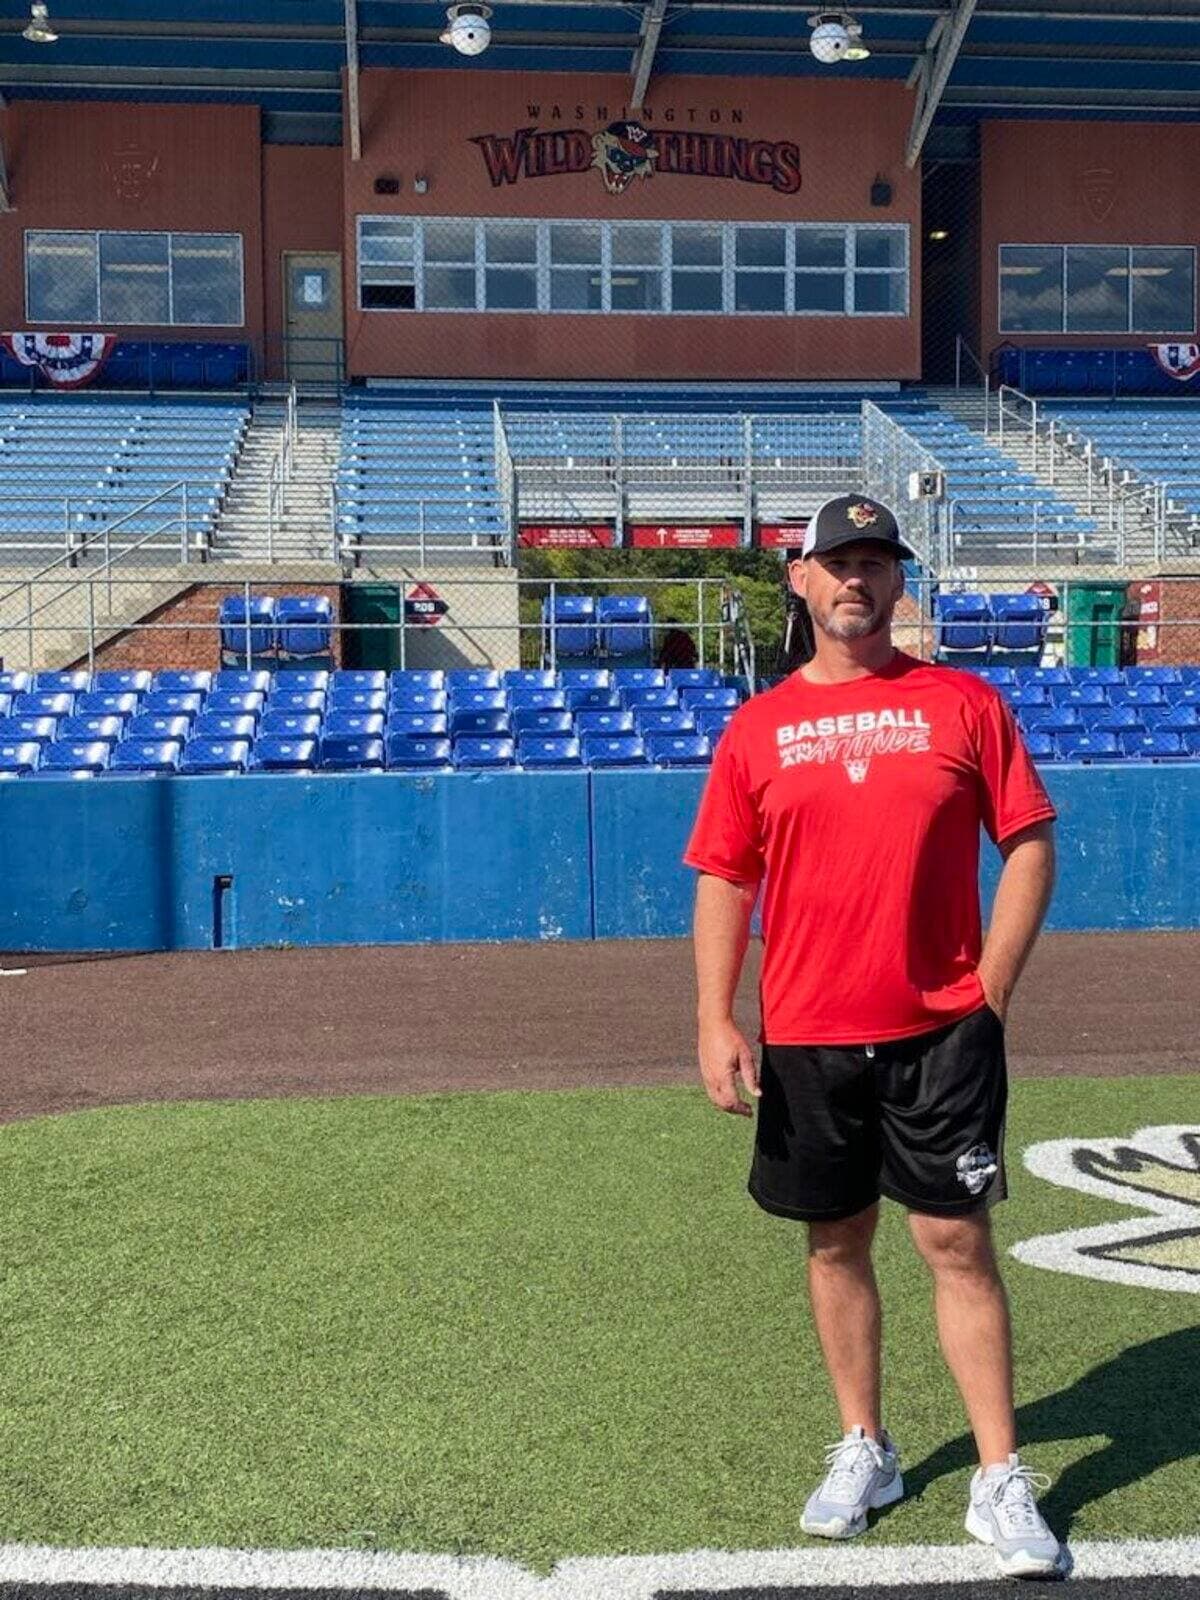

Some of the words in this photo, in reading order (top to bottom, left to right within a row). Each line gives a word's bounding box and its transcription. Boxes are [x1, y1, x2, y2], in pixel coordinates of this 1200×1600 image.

[526, 104, 744, 124] WASHINGTON
[468, 127, 596, 187] WILD
[650, 129, 803, 194] THINGS
[776, 708, 931, 746] BASEBALL
